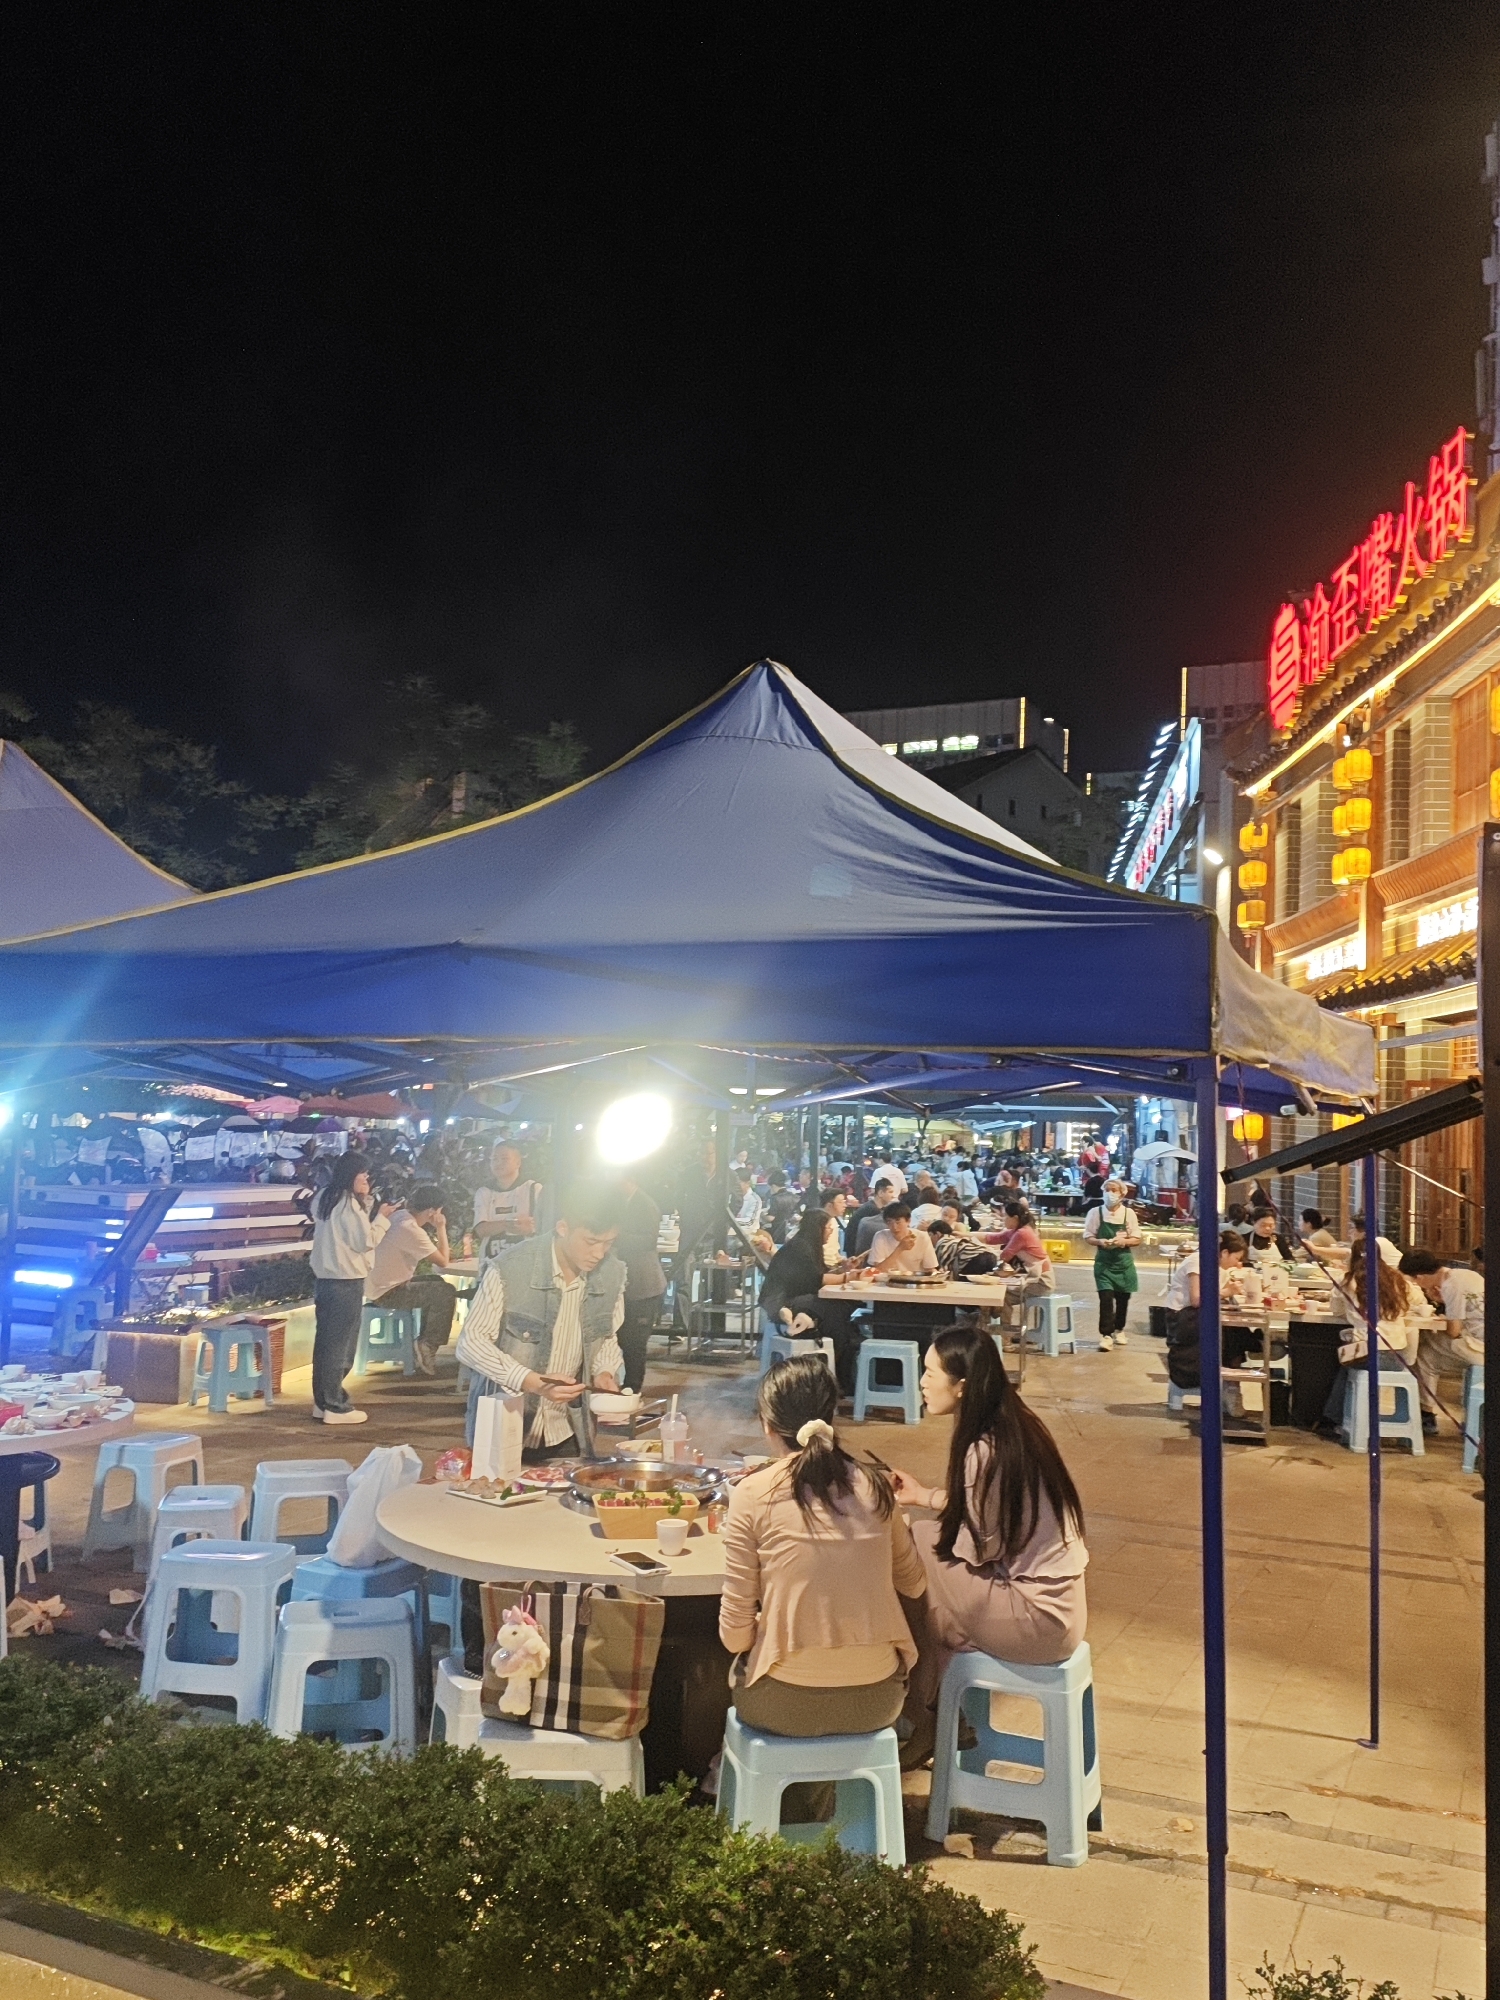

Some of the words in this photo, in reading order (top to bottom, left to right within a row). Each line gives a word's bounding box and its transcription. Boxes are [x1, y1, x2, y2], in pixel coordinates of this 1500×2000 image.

[1303, 426, 1468, 685] 渝歪嘴火锅
